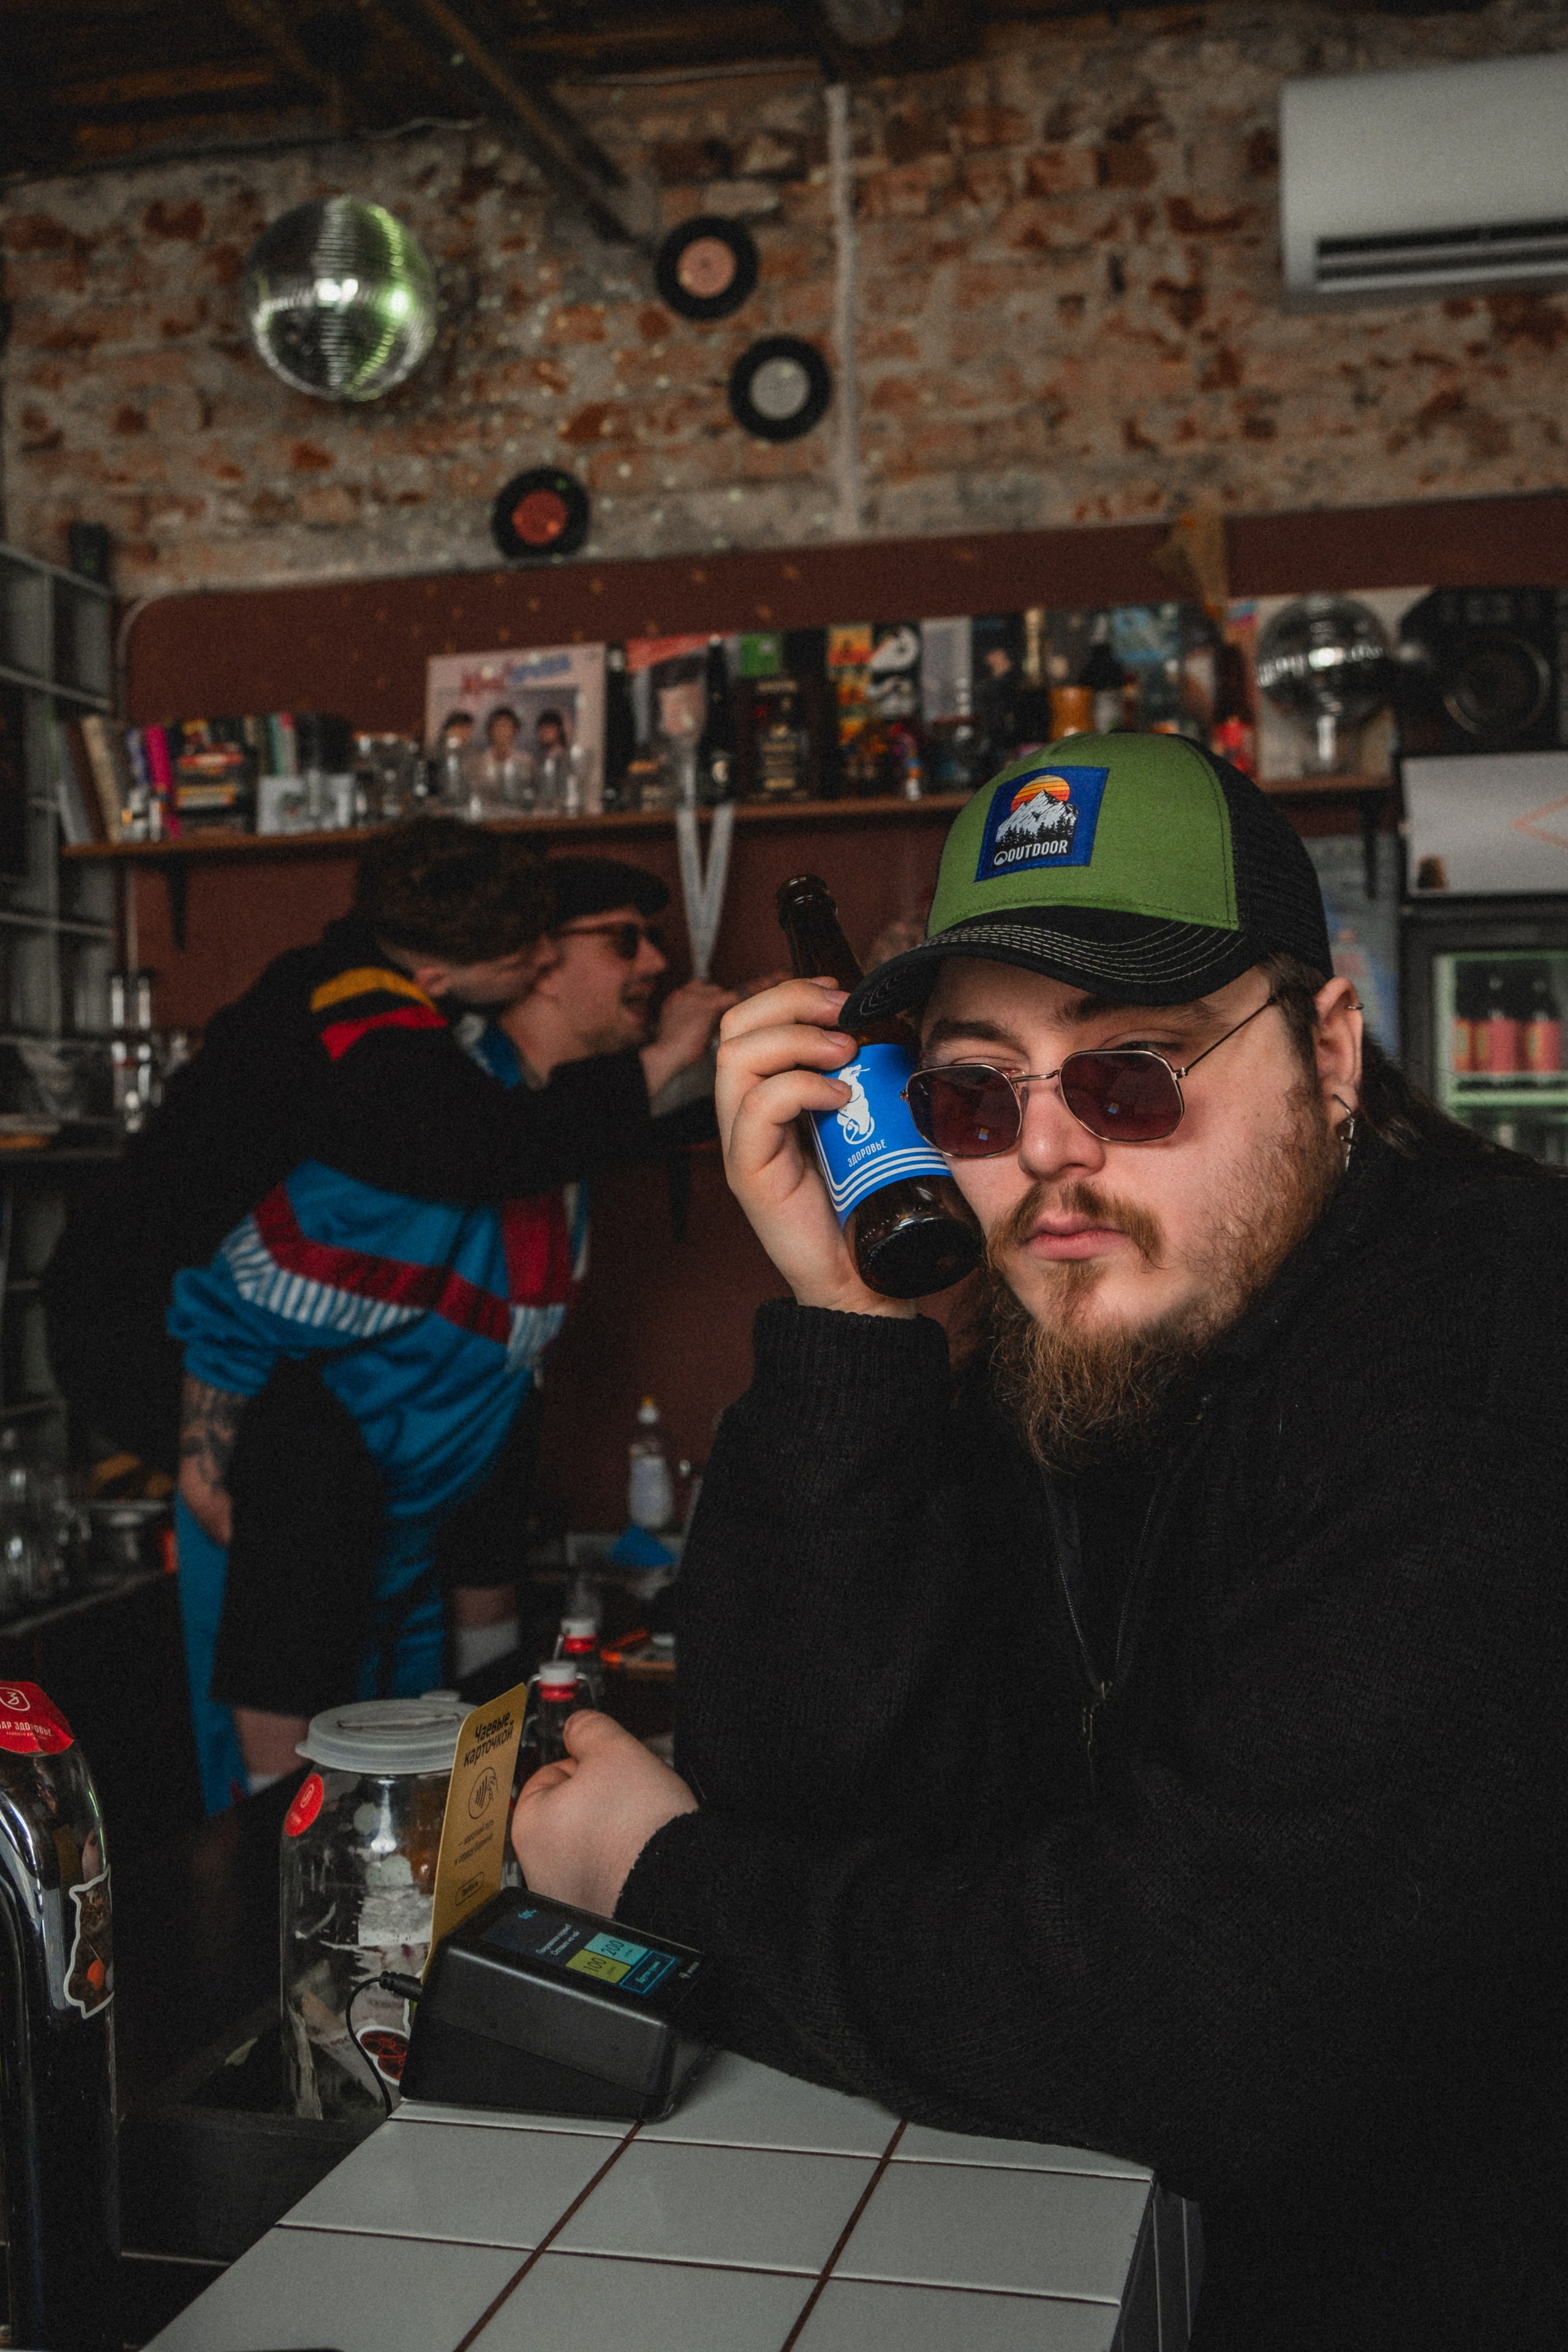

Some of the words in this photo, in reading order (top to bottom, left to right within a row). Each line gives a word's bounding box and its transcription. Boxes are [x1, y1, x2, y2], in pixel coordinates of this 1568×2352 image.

[1007, 840, 1068, 862] OUTDOOR
[847, 1139, 887, 1167] ЗДОРОВЬЕ
[14, 1722, 53, 1736] ЗДОРОВЬЕ
[475, 1712, 511, 1743] Чаевые
[464, 1719, 514, 1767] карточкой
[601, 1940, 625, 1956] 200
[583, 1958, 606, 1972] 100
